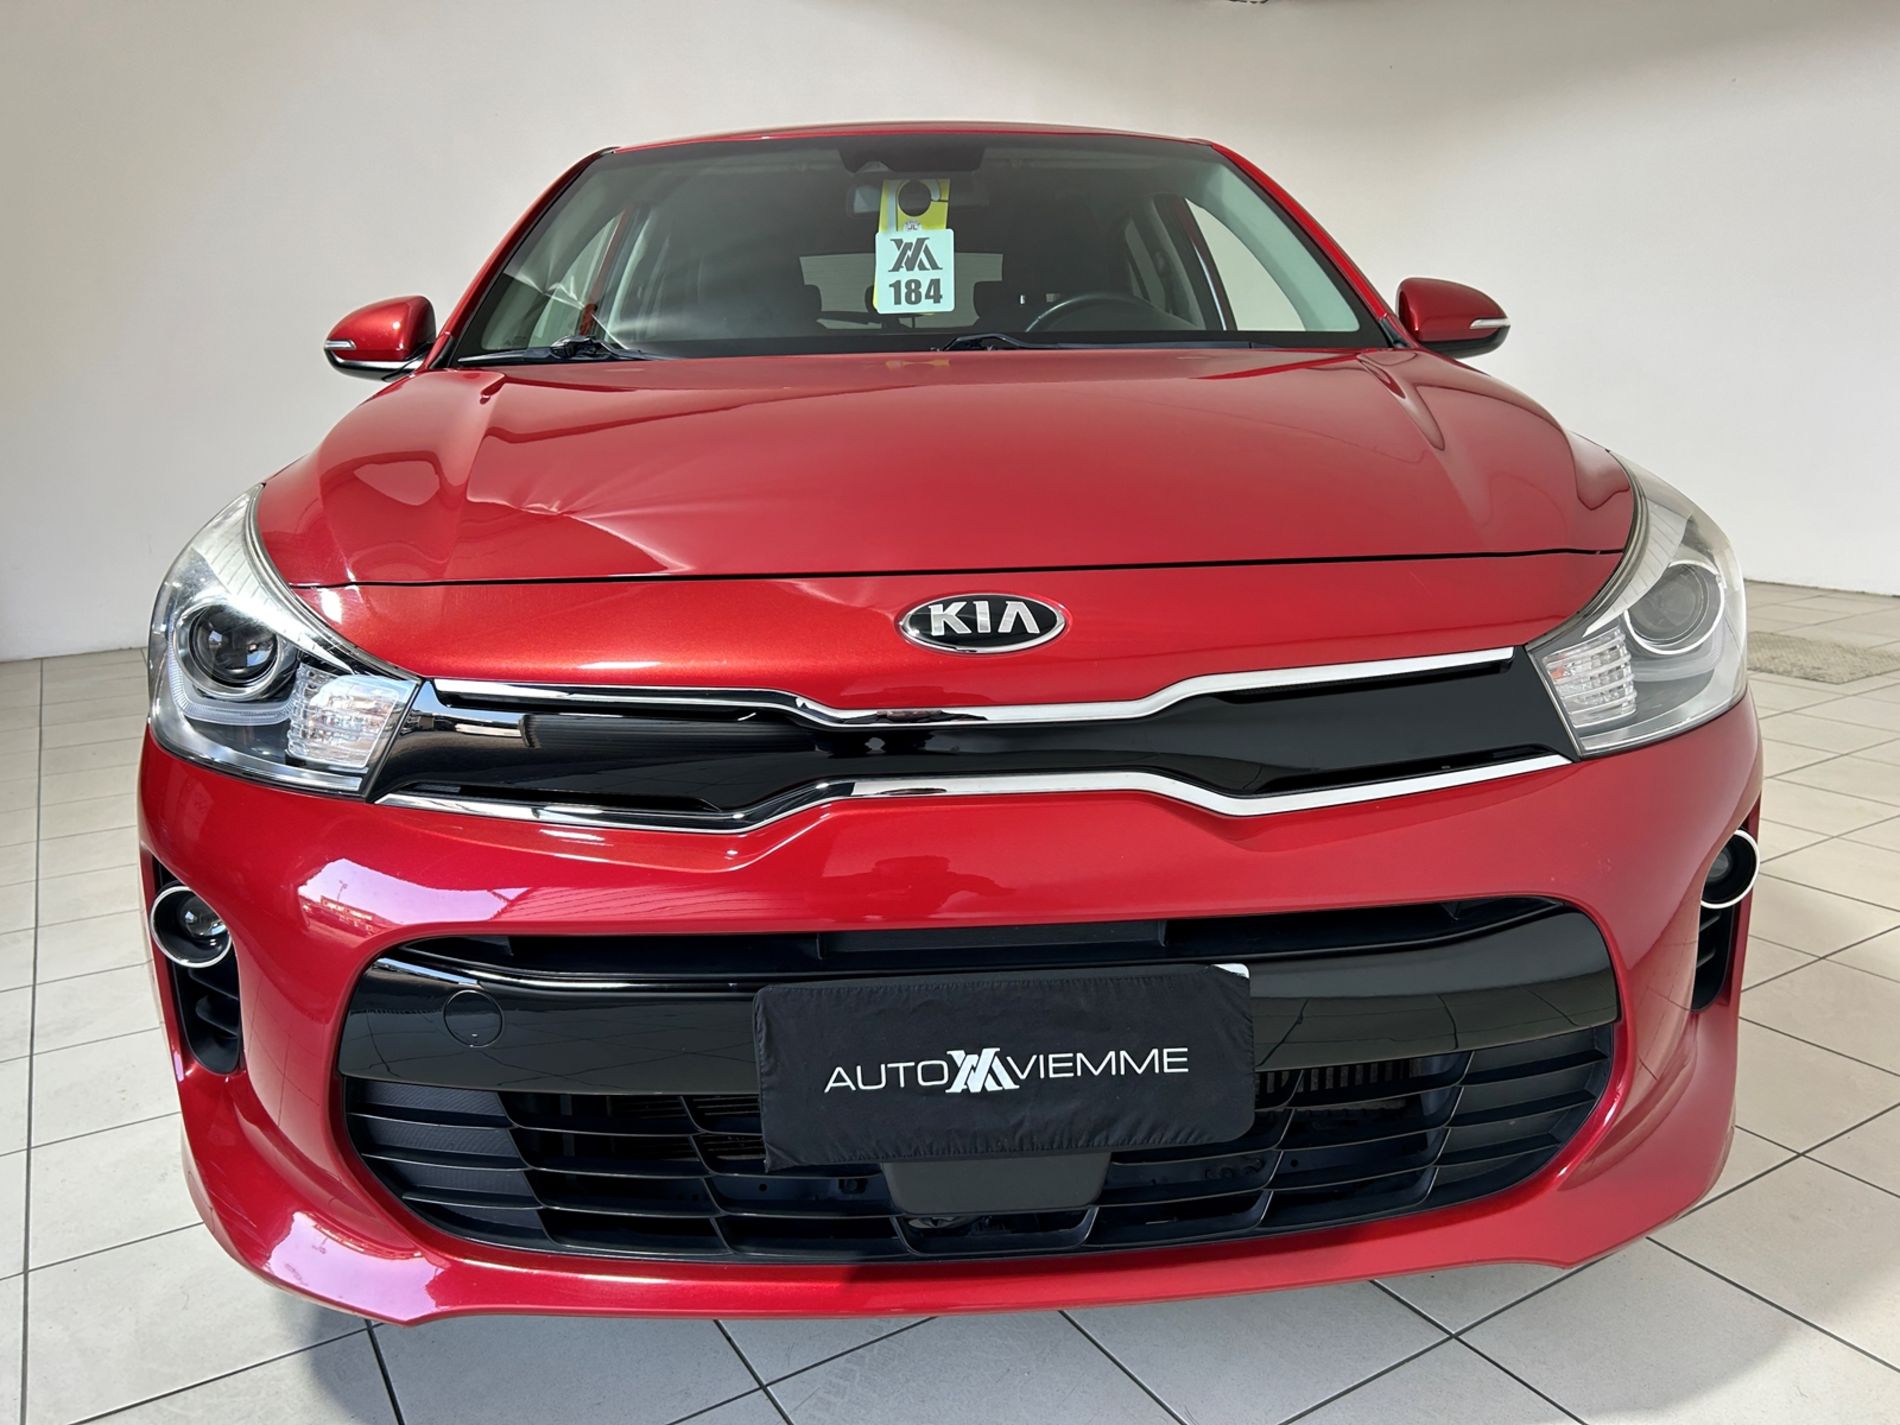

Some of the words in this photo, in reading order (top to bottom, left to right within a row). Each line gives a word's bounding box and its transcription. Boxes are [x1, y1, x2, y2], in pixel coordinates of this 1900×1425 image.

[889, 278, 943, 306] 184
[928, 600, 1041, 637] KIA
[824, 1061, 948, 1093] AUTO
[1006, 1047, 1190, 1080] VIEMME
